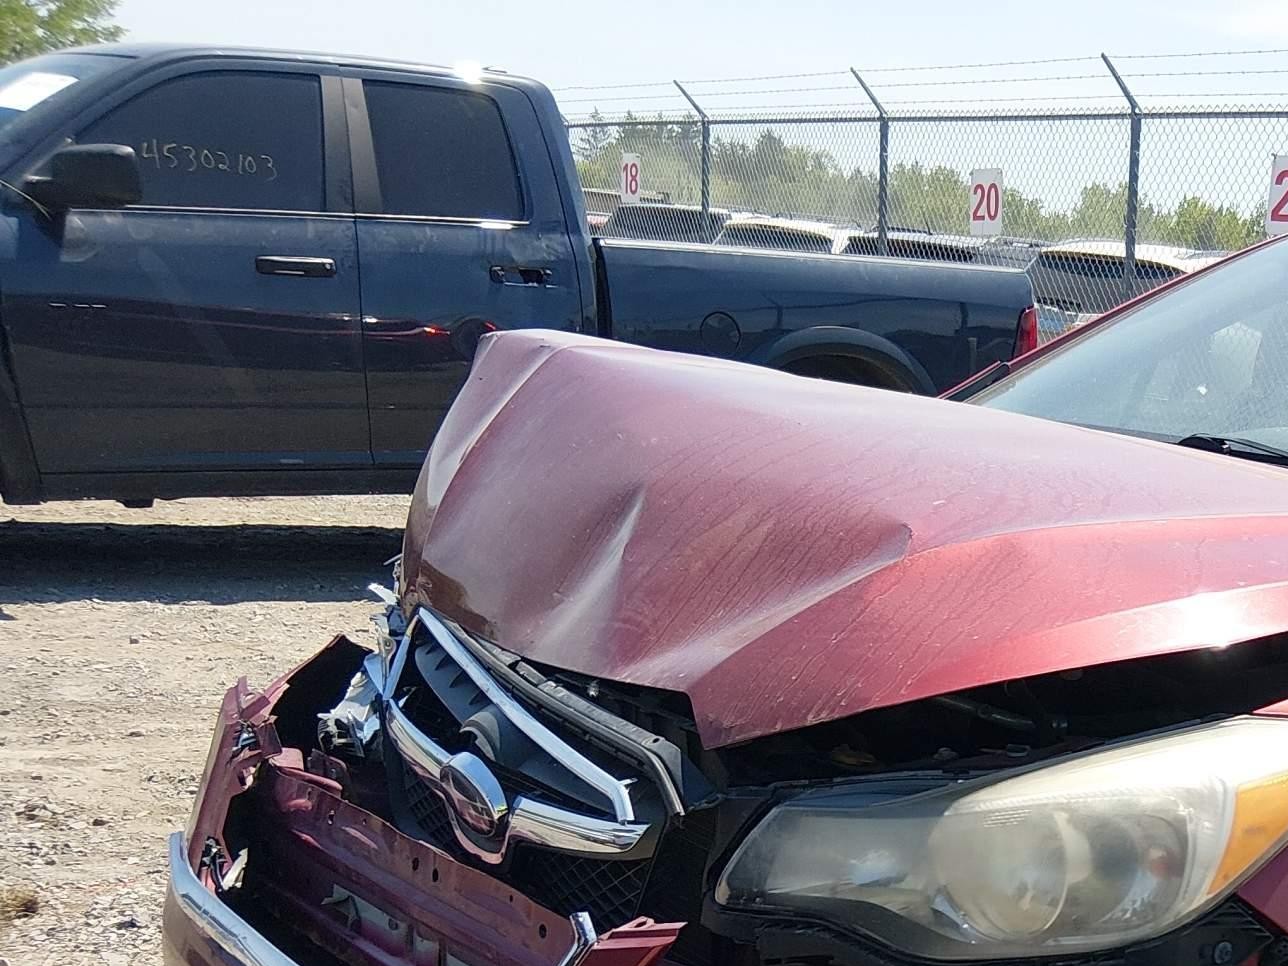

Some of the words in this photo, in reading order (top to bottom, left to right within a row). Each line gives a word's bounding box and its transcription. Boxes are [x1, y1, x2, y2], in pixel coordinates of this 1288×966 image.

[142, 139, 277, 181] 45302103
[623, 163, 638, 195] 18
[973, 183, 999, 221] 20
